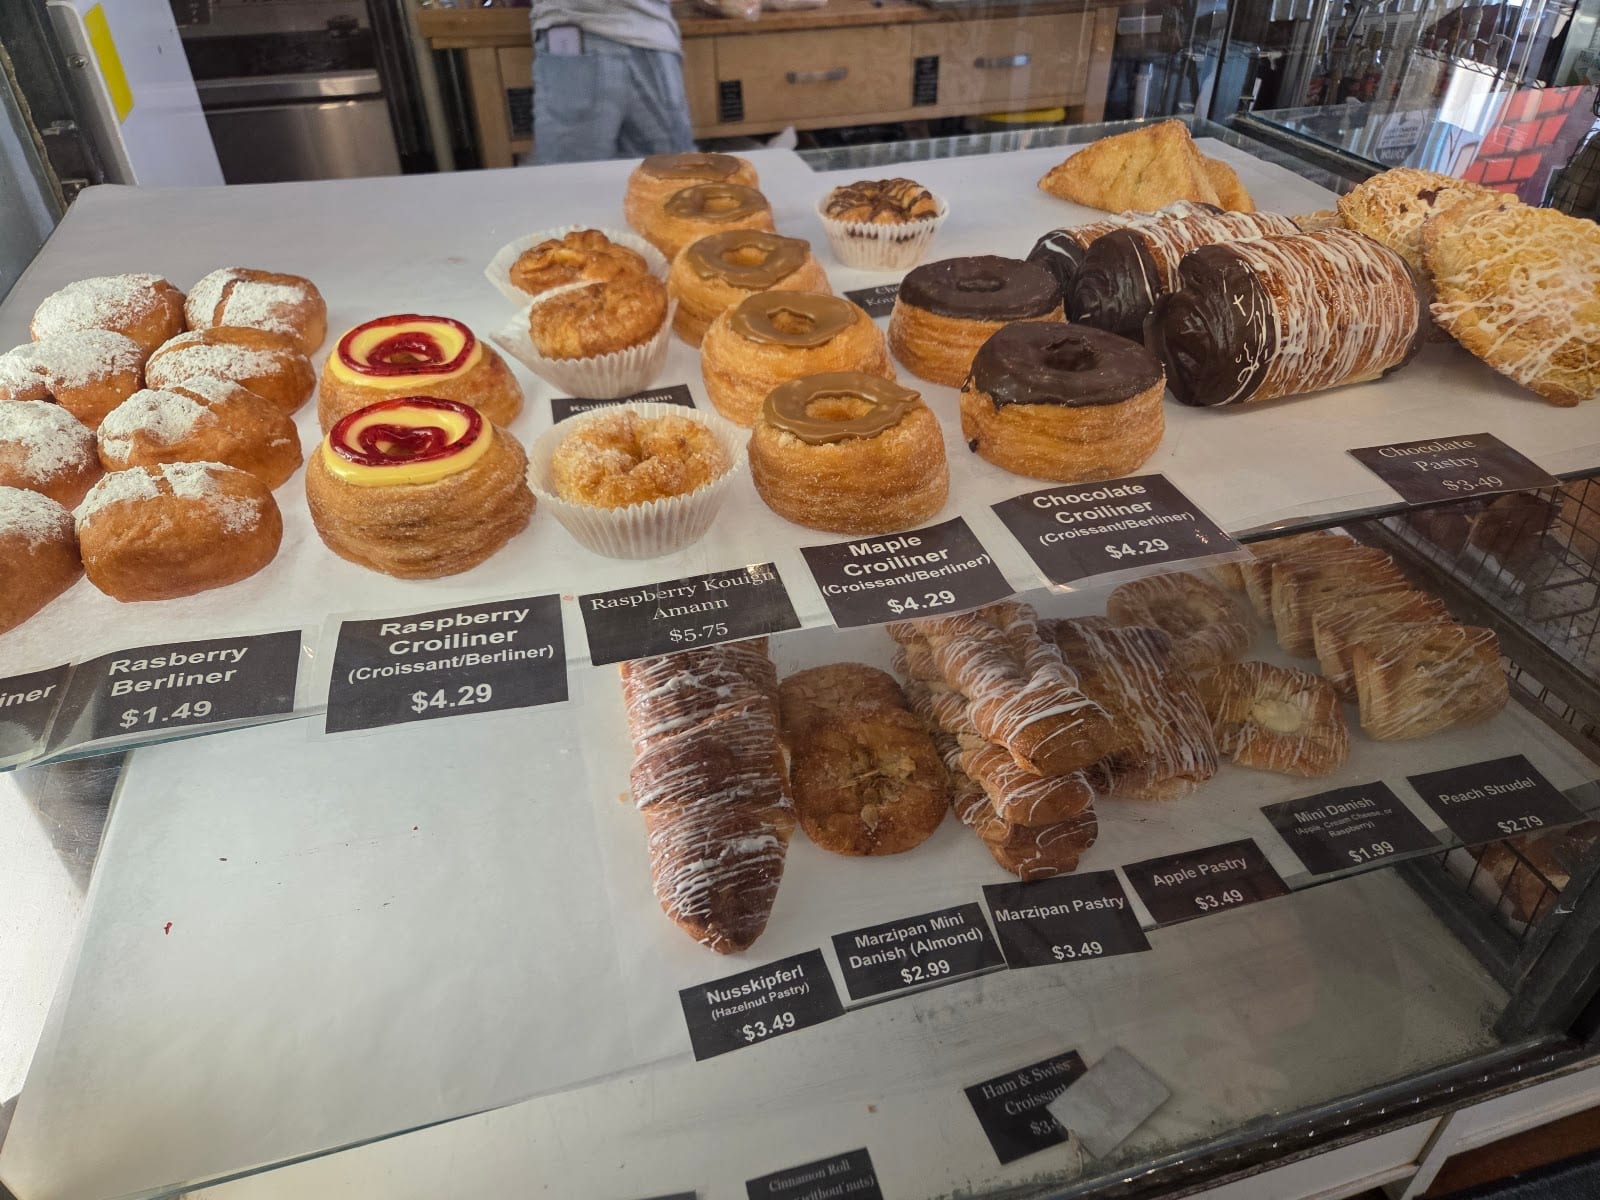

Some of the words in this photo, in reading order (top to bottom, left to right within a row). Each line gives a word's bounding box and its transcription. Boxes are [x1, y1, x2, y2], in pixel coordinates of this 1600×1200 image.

[1378, 439, 1477, 459] Chocolate
[1414, 455, 1479, 472] Pastry
[1033, 482, 1147, 509] Chocolate
[1442, 475, 1503, 492] $3.49
[1055, 499, 1153, 524] Croiliner
[1039, 511, 1196, 547] (Croissant/Berliner)
[849, 536, 922, 557] Maple
[1105, 538, 1169, 560] $4.29
[822, 553, 991, 596] (Croissant/Berliner)
[843, 548, 949, 577] Croiliner
[591, 584, 696, 611] Raspberry
[702, 571, 776, 592] Kouign
[887, 590, 956, 614] $4.29
[380, 608, 530, 637] Raspberry
[652, 599, 729, 620] Amann
[389, 628, 518, 655] Croiliner
[669, 622, 728, 643] $5.75
[108, 647, 248, 676] Rasberry
[348, 645, 554, 684] (Croissant/Berliner)
[110, 669, 238, 697] Berliner
[411, 683, 493, 713] $4.29
[119, 700, 212, 729] $1.49
[1438, 788, 1485, 805] Peach
[1484, 776, 1536, 796] Strudel
[1294, 808, 1325, 823] Mini
[1325, 798, 1376, 816] Danish
[1497, 815, 1544, 834] $2.79
[1348, 841, 1394, 863] $1.99
[1153, 868, 1197, 887] Apple
[1198, 857, 1248, 875] Pastry
[995, 903, 1070, 923] Marzipan
[1073, 896, 1125, 914] Pastry
[1195, 889, 1244, 911] $3.49
[854, 922, 928, 949] Marzipan
[929, 912, 965, 932] Mini
[849, 944, 907, 969] Danish
[910, 927, 984, 958] (Almond)
[1051, 940, 1103, 961] $3.49
[706, 964, 804, 1005] Nusskipferl
[900, 959, 951, 985] $2.99
[711, 996, 768, 1021] (Hazelnut
[768, 983, 810, 1002] Pastry)
[742, 1011, 796, 1042] $3.49
[981, 1081, 1018, 1100] Ham
[1017, 1073, 1032, 1087] &
[1031, 1060, 1071, 1082] Swiss
[768, 1169, 826, 1192] Cinnamon
[827, 1159, 850, 1176] Roll
